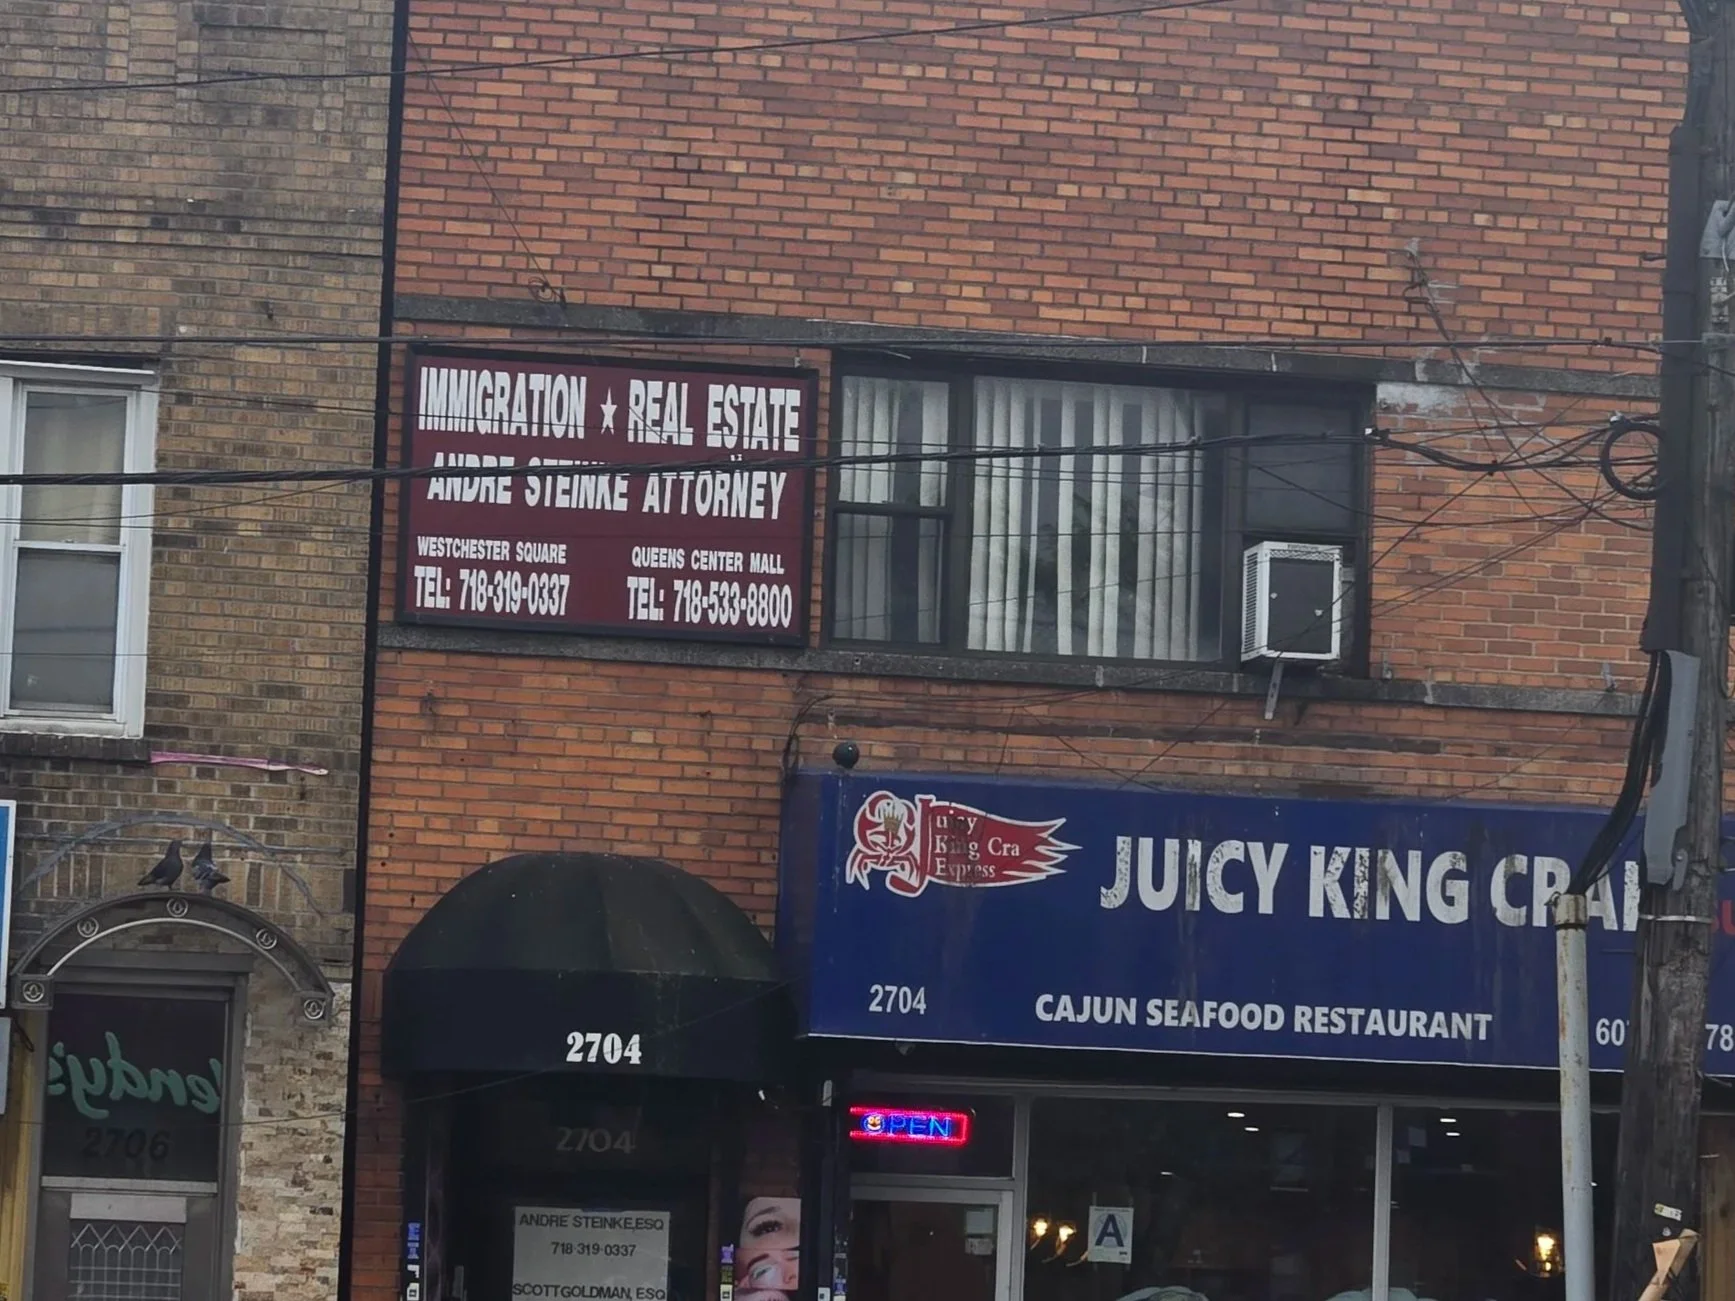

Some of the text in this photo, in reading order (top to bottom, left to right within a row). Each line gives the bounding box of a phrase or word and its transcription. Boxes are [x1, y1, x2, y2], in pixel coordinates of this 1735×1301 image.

[418, 366, 801, 452] IMMIGRATION REAL ESTATE
[427, 452, 787, 520] ANDRE STEINKE ATTORNEY
[417, 535, 567, 564] WESTCHESTER SQUARE
[632, 546, 785, 575] QUEENS CENTER MALL
[414, 566, 570, 616] TEL: 718-319-0337
[627, 576, 793, 629] TEL: 718-533-8800
[1100, 835, 1290, 915] JUICY
[1308, 845, 1470, 924] KING
[868, 984, 927, 1015] 2704
[1035, 993, 1492, 1041] CAJUN SEAFOOD RESTAURANT
[1595, 1017, 1630, 1047] 60
[565, 1031, 642, 1064] 2704
[556, 1126, 637, 1154] 2704
[863, 1112, 952, 1140] OPEN
[82, 1126, 171, 1161] 2706
[519, 1213, 569, 1227] ANDRE
[1095, 1213, 1125, 1247] A
[636, 1286, 666, 1301] ESQ
